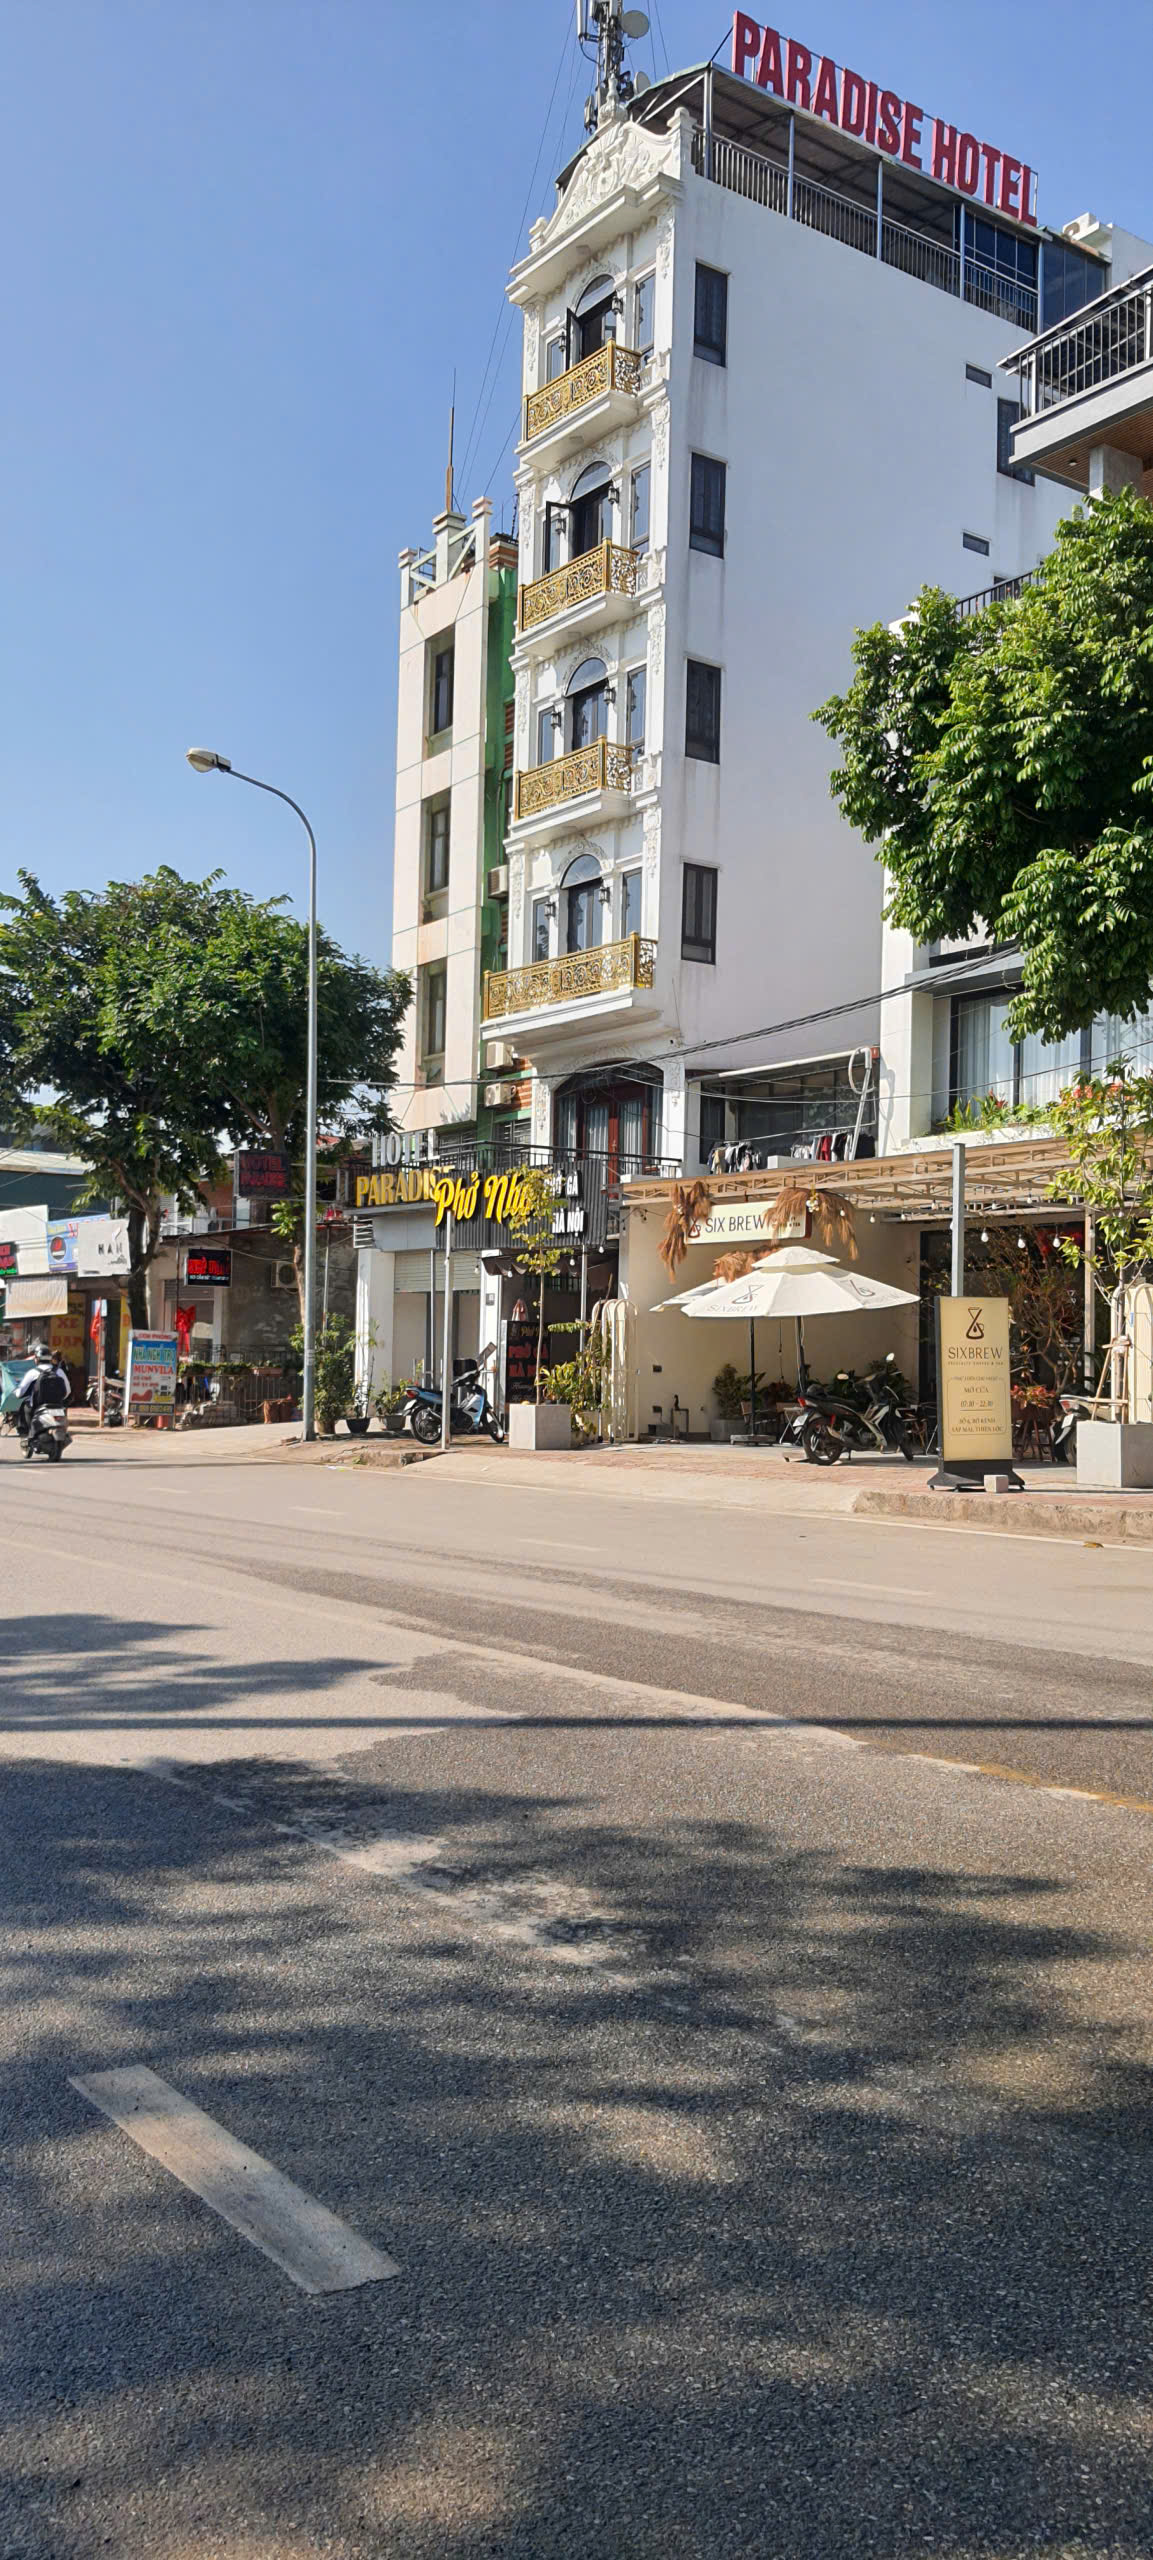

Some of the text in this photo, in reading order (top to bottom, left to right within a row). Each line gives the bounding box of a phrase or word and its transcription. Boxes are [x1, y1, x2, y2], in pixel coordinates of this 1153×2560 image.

[731, 10, 1037, 227] PARADISE HOTEL
[566, 1170, 579, 1196] GÀ
[434, 1170, 480, 1228] Phở
[567, 1206, 585, 1238] NỘI
[704, 1214, 766, 1234] SIX BREW
[948, 1347, 1003, 1359] SIXBREW
